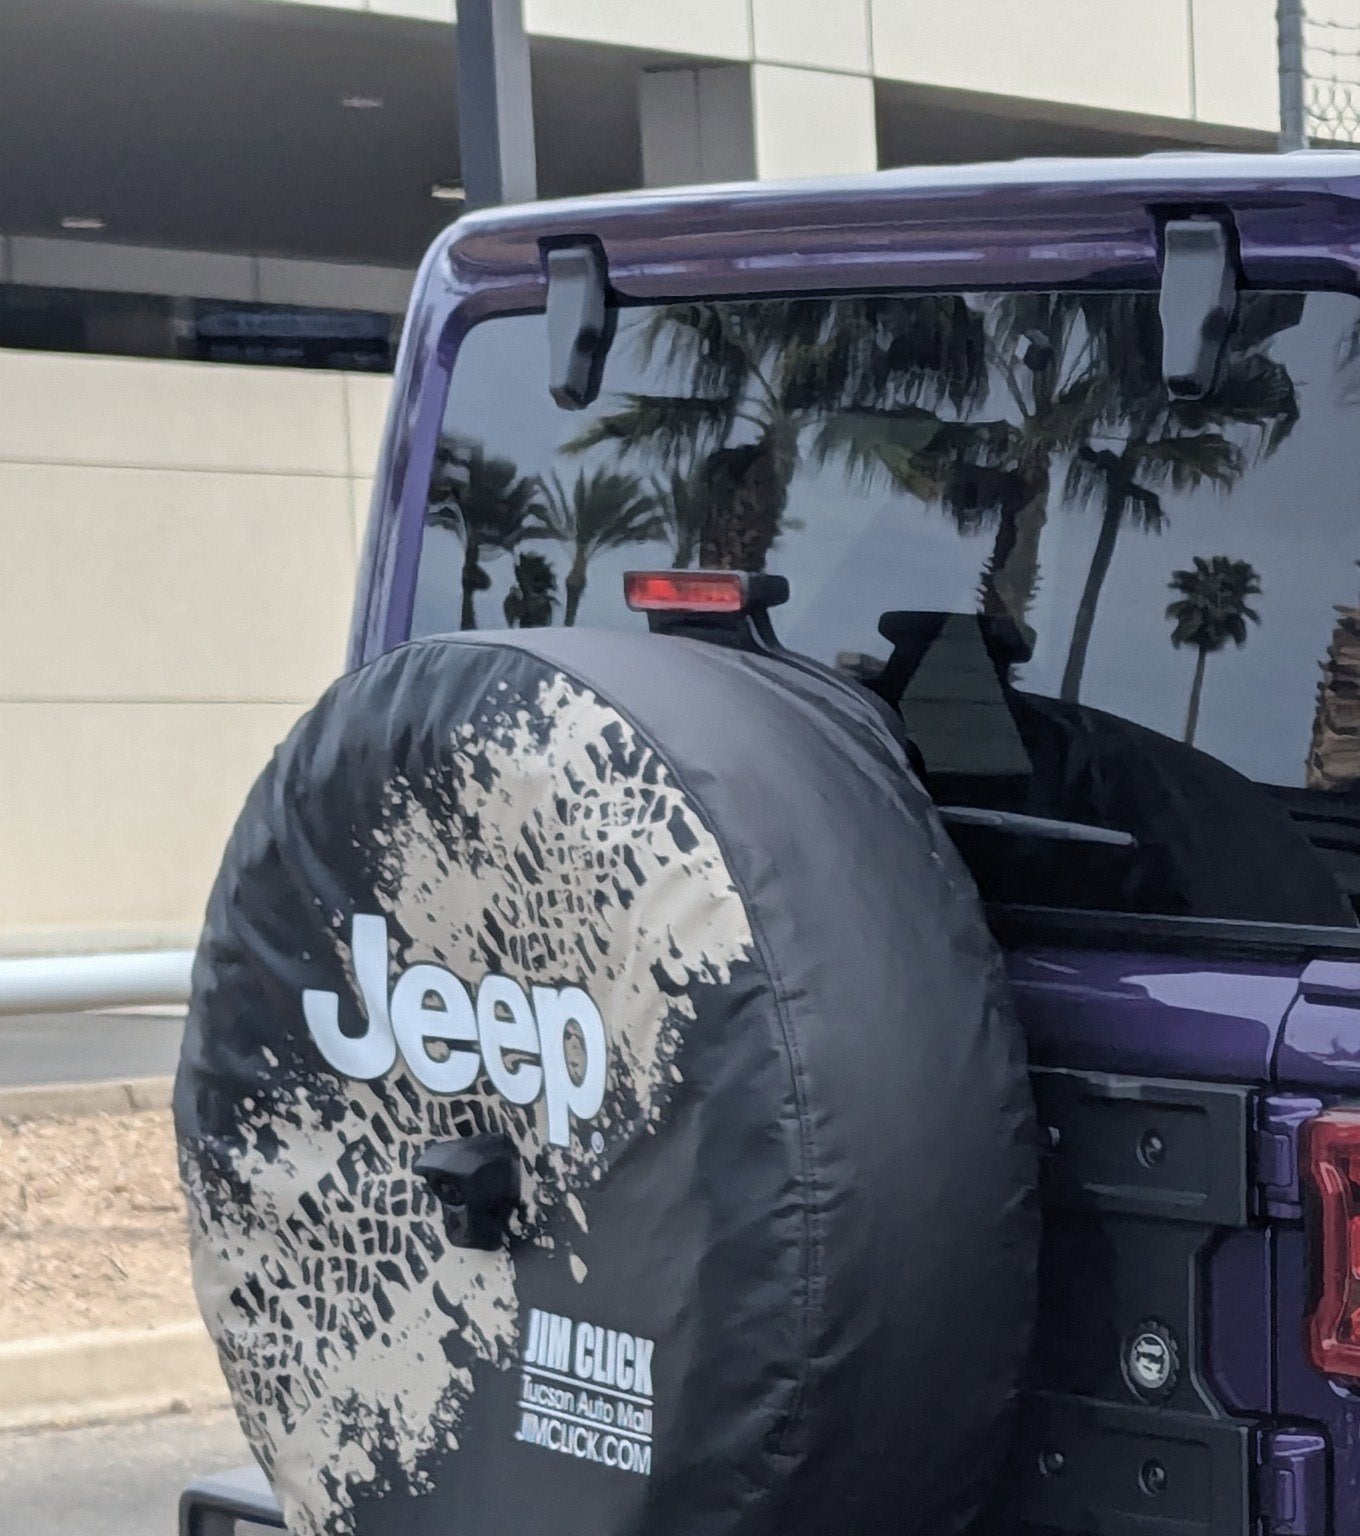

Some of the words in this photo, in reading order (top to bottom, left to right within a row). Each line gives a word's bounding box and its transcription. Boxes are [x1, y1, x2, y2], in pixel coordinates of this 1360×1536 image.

[303, 913, 607, 1147] Jeep
[524, 1308, 572, 1372] JIM
[575, 1321, 654, 1396] CLICK
[522, 1374, 575, 1410] Tucson
[577, 1391, 614, 1424] Auto
[617, 1402, 653, 1435] Mall
[514, 1412, 652, 1476] JIMCLICK.COM
